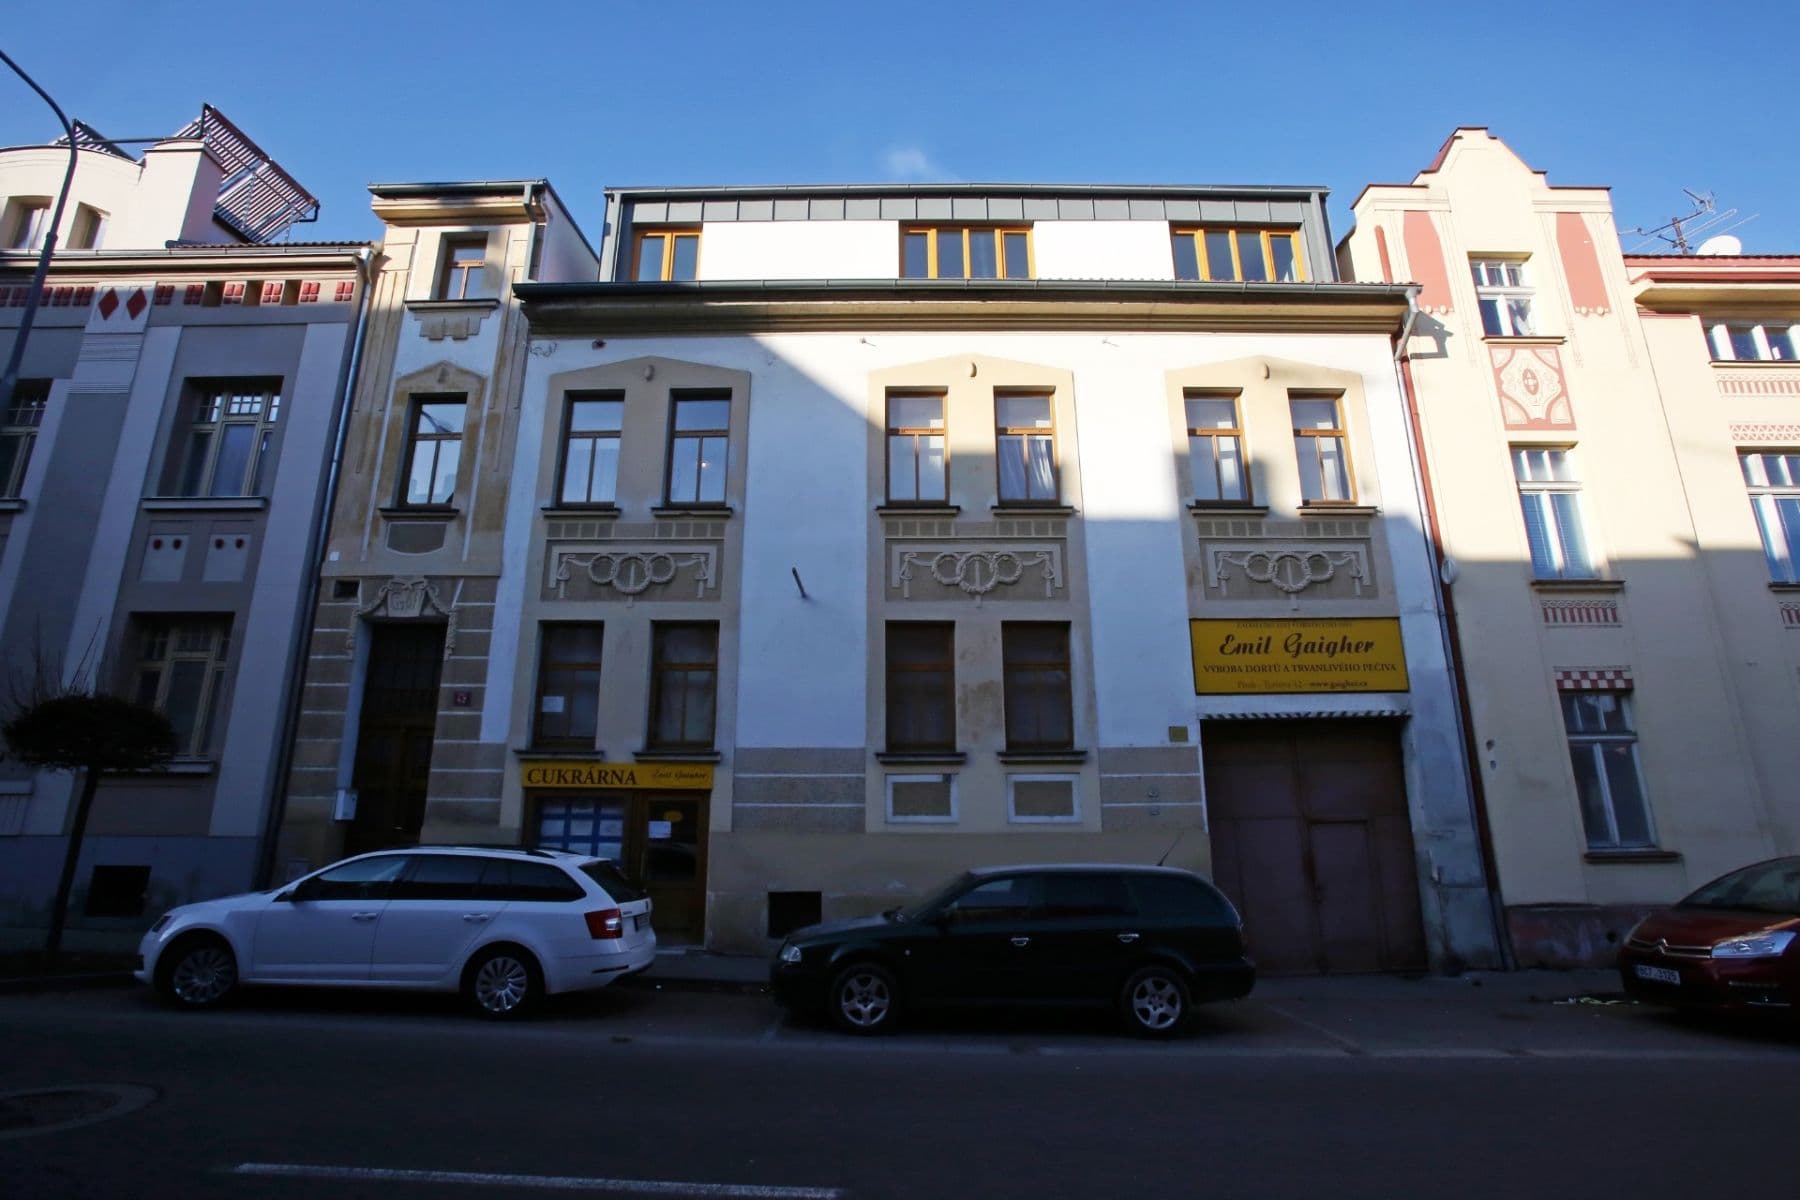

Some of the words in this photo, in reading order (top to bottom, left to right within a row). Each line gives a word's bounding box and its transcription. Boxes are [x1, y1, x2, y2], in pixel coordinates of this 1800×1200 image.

[1220, 634, 1271, 656] Emil
[1283, 632, 1375, 658] Gaigher
[1203, 662, 1242, 672] VÝROBA
[1245, 661, 1281, 673] DORTŮ
[1283, 664, 1291, 672] A
[1291, 661, 1361, 672] TRVANLIVÉHO
[1363, 660, 1397, 672] PEČIVA
[527, 766, 638, 785] CUKRÁRNA
